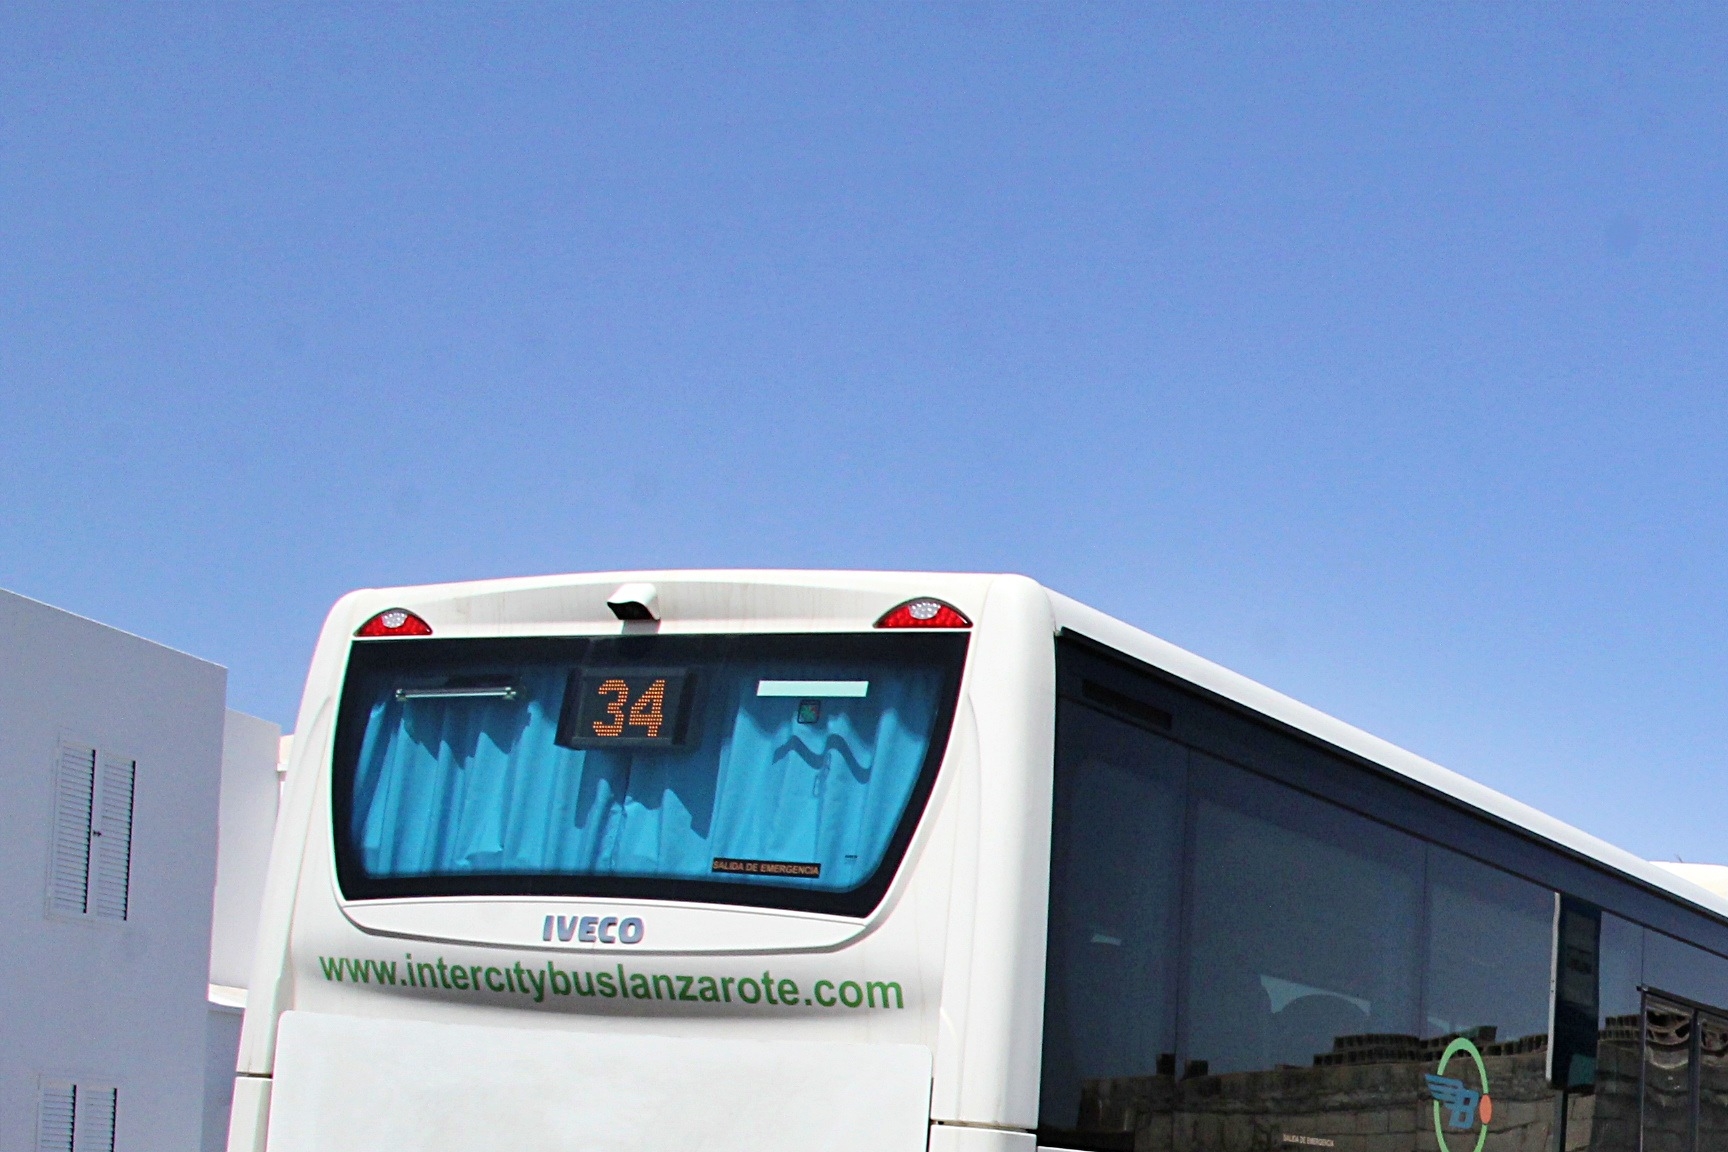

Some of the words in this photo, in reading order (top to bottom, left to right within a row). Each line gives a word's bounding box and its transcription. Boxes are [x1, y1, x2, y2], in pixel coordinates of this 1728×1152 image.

[593, 680, 665, 737] 34
[713, 860, 744, 871] SALIDA
[746, 863, 758, 872] DE
[760, 864, 819, 875] EMERGENCIA
[543, 915, 645, 945] IVECO
